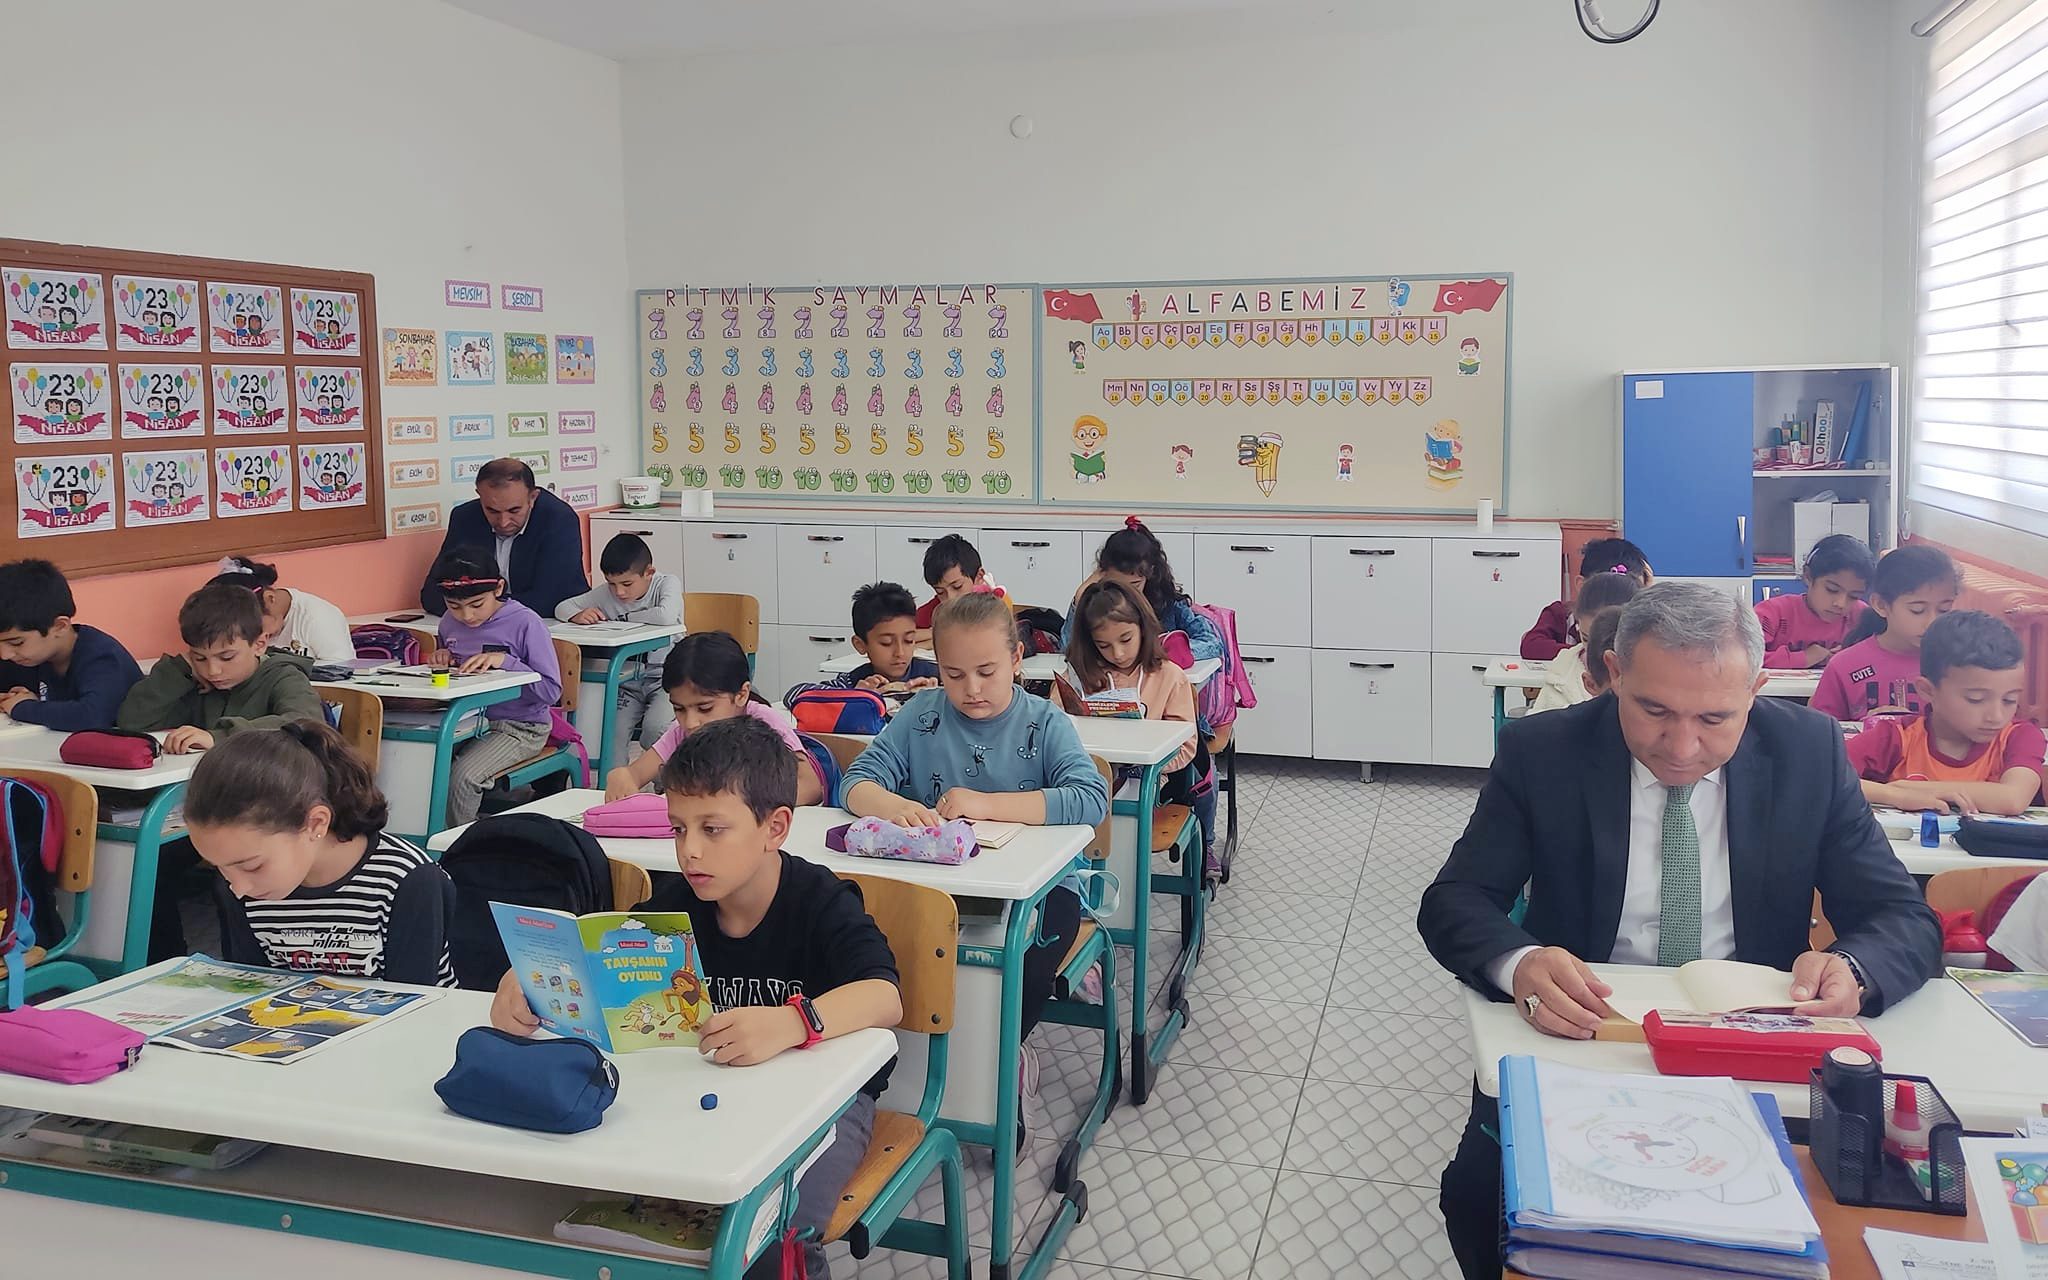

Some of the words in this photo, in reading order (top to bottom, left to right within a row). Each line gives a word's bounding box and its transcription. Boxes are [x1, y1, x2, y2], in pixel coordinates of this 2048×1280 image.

[41, 282, 68, 304] 23
[145, 288, 168, 308] 23
[453, 286, 483, 301] MEVSİM
[512, 291, 534, 307] ŞERİDİ
[666, 283, 776, 307] RİTMİK
[814, 284, 997, 306] SAYMALAR
[1162, 285, 1366, 314] ALFABEMİZ
[235, 293, 255, 312] 23
[316, 300, 334, 317] 23
[1098, 328, 1109, 336] Aa
[1119, 327, 1130, 335] Bb
[1142, 327, 1153, 335] Cc
[1164, 325, 1177, 335] Çç
[1187, 326, 1200, 334] Dd
[1210, 325, 1222, 333] Ee
[1234, 324, 1244, 332] Ff
[1257, 324, 1269, 333] Gg
[1281, 323, 1293, 333] Ğğ
[1381, 322, 1389, 331] Jj
[1403, 322, 1416, 330] Kk
[399, 333, 434, 345] SONBAHAR
[479, 337, 490, 351] KIŞ
[49, 374, 75, 396] 23
[151, 374, 173, 394] 23
[239, 375, 260, 393] 23
[319, 376, 338, 393] 23
[1200, 383, 1211, 392] Pp
[1245, 383, 1257, 391] Ss
[1268, 382, 1280, 392] Şş
[1315, 383, 1328, 391] Uu
[1339, 381, 1353, 390] Üü
[1389, 381, 1401, 391] Yy
[1414, 382, 1426, 390] Zz
[243, 457, 263, 475] 23
[323, 453, 340, 470] 23
[469, 464, 483, 473] OCA
[53, 466, 79, 488] 23
[155, 461, 177, 481] 23
[1852, 667, 1874, 681] CUTE
